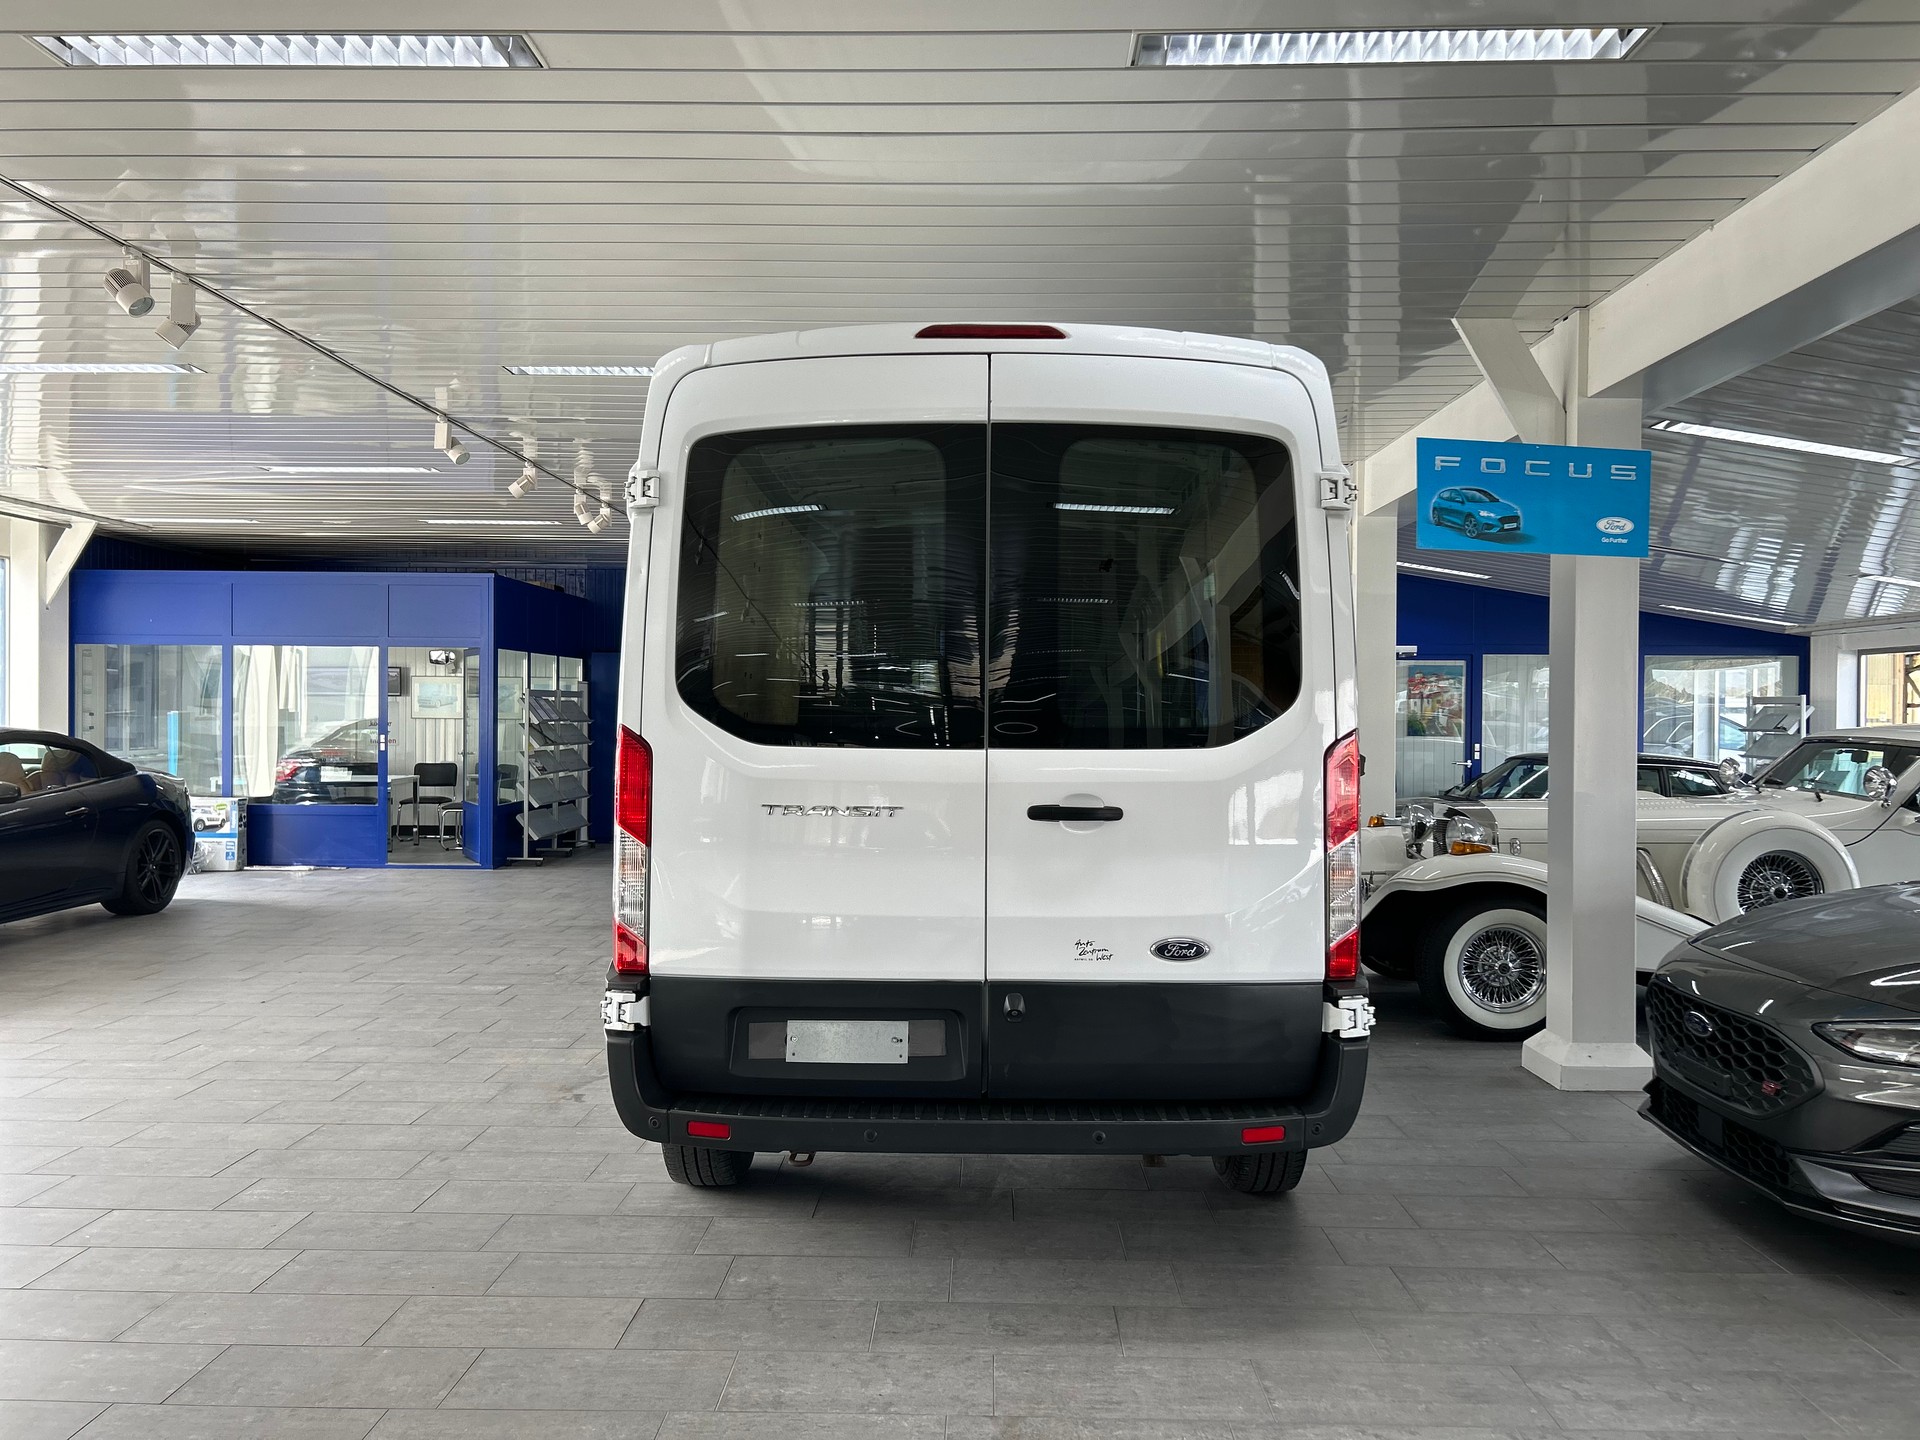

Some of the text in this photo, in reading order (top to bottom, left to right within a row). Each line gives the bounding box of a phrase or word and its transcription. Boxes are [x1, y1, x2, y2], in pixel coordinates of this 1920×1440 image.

[1434, 456, 1637, 481] FOCUS
[1604, 520, 1627, 531] Ford
[761, 804, 904, 818] TRANSIT
[1164, 943, 1198, 957] Ford
